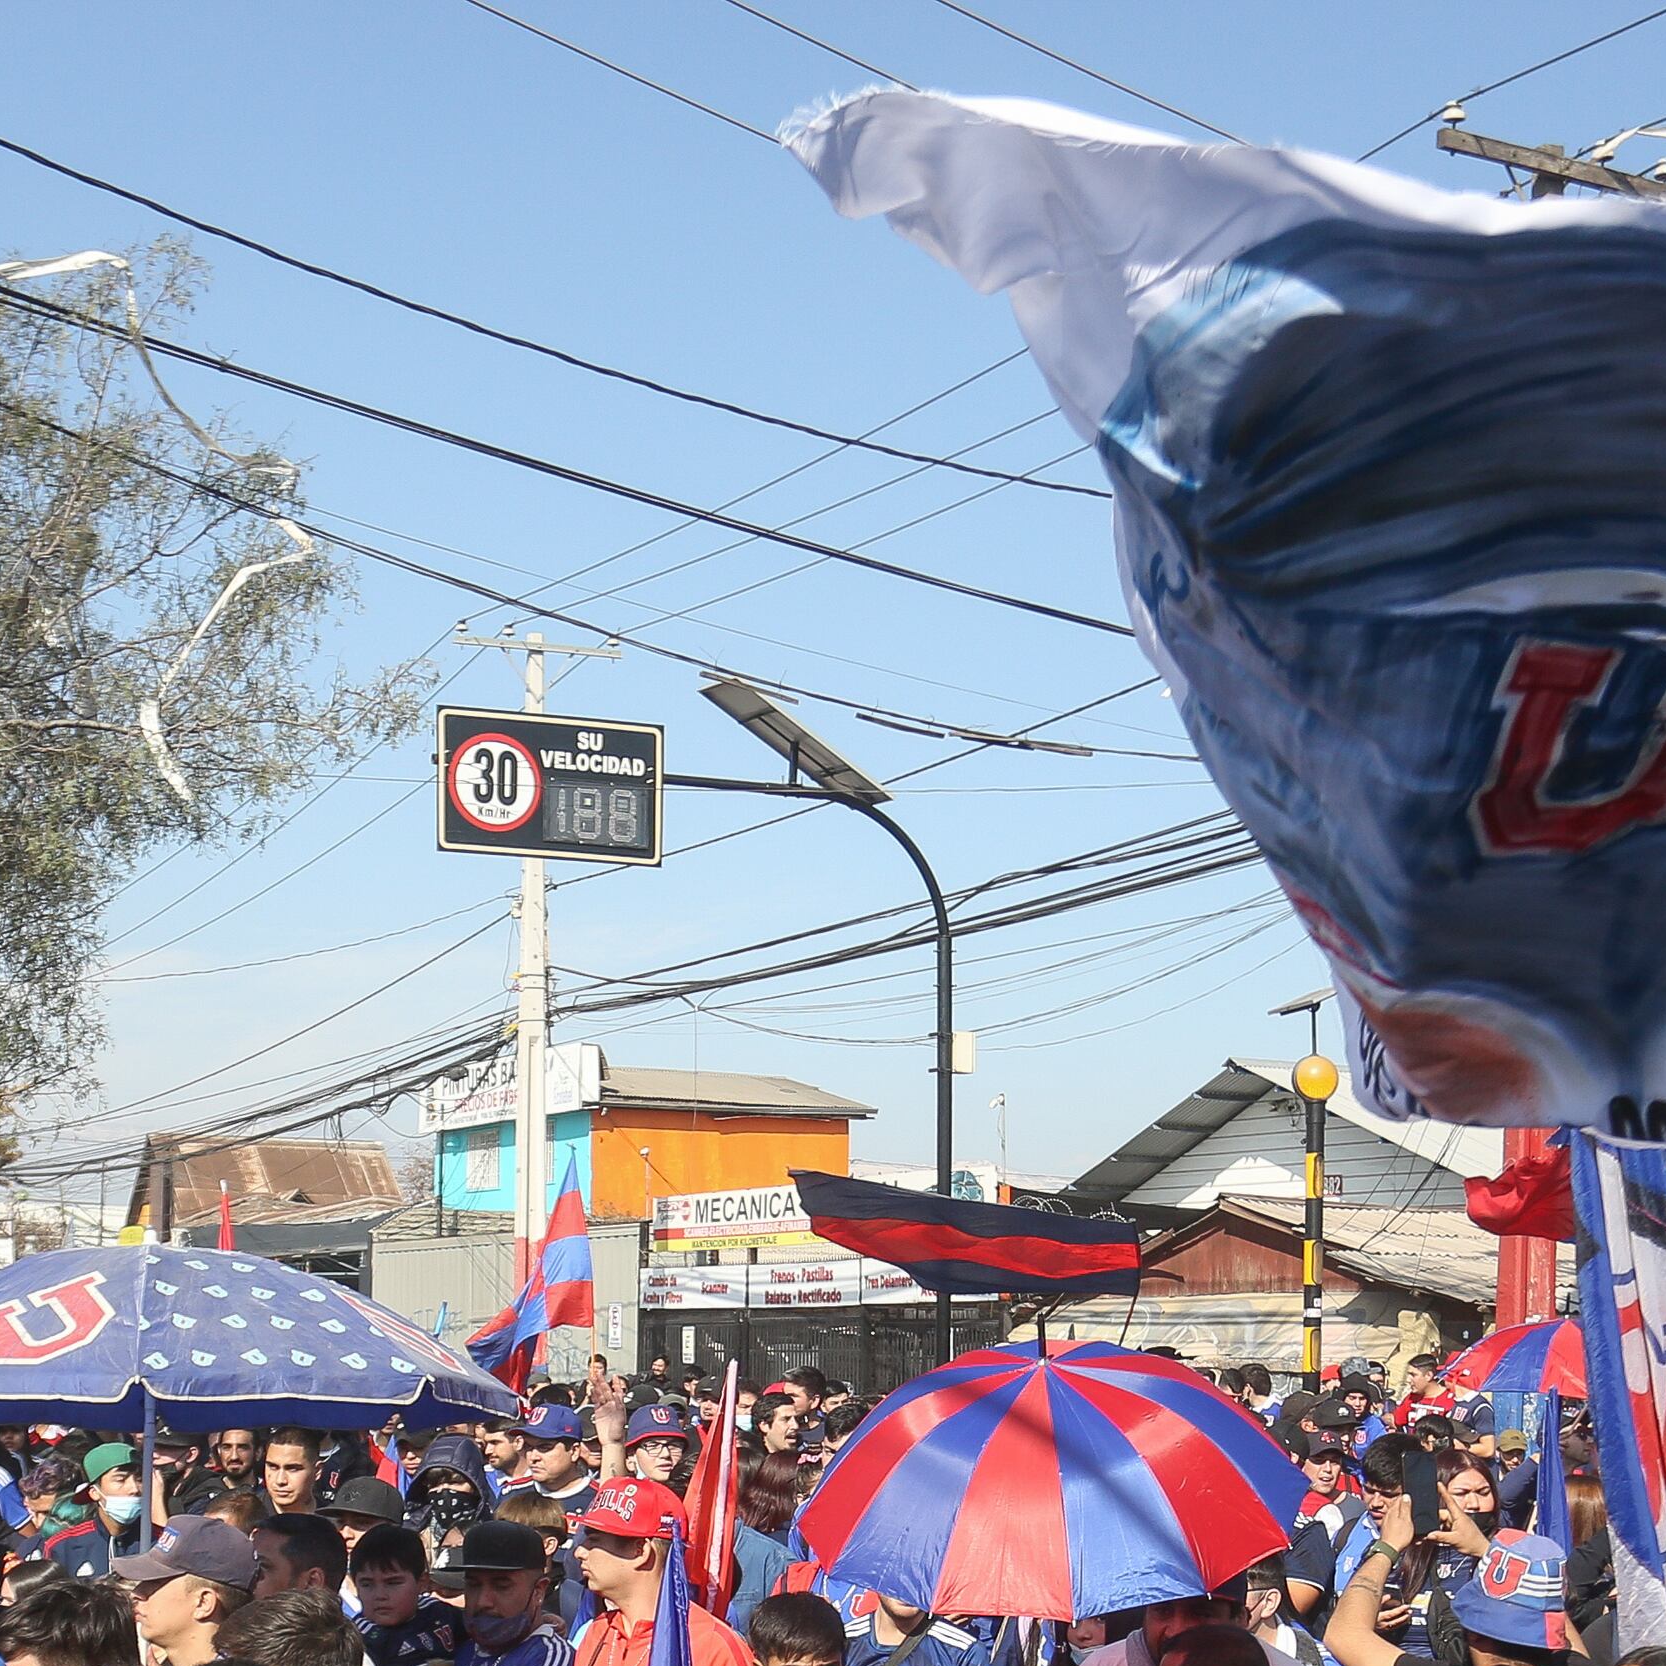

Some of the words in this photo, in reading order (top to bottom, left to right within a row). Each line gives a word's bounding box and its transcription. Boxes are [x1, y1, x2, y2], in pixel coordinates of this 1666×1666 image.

[576, 731, 604, 751] SU
[539, 749, 646, 777] VELOCIDAD
[473, 747, 518, 806] 30
[694, 1191, 796, 1224] MECANICA
[770, 1269, 796, 1284] Frenos
[801, 1266, 834, 1283] Pastillas
[864, 1274, 879, 1289] Tren
[880, 1274, 913, 1289] Delantero
[701, 1281, 729, 1295] Scanner
[797, 1288, 842, 1303] Rectificado
[1477, 1546, 1532, 1601] U
